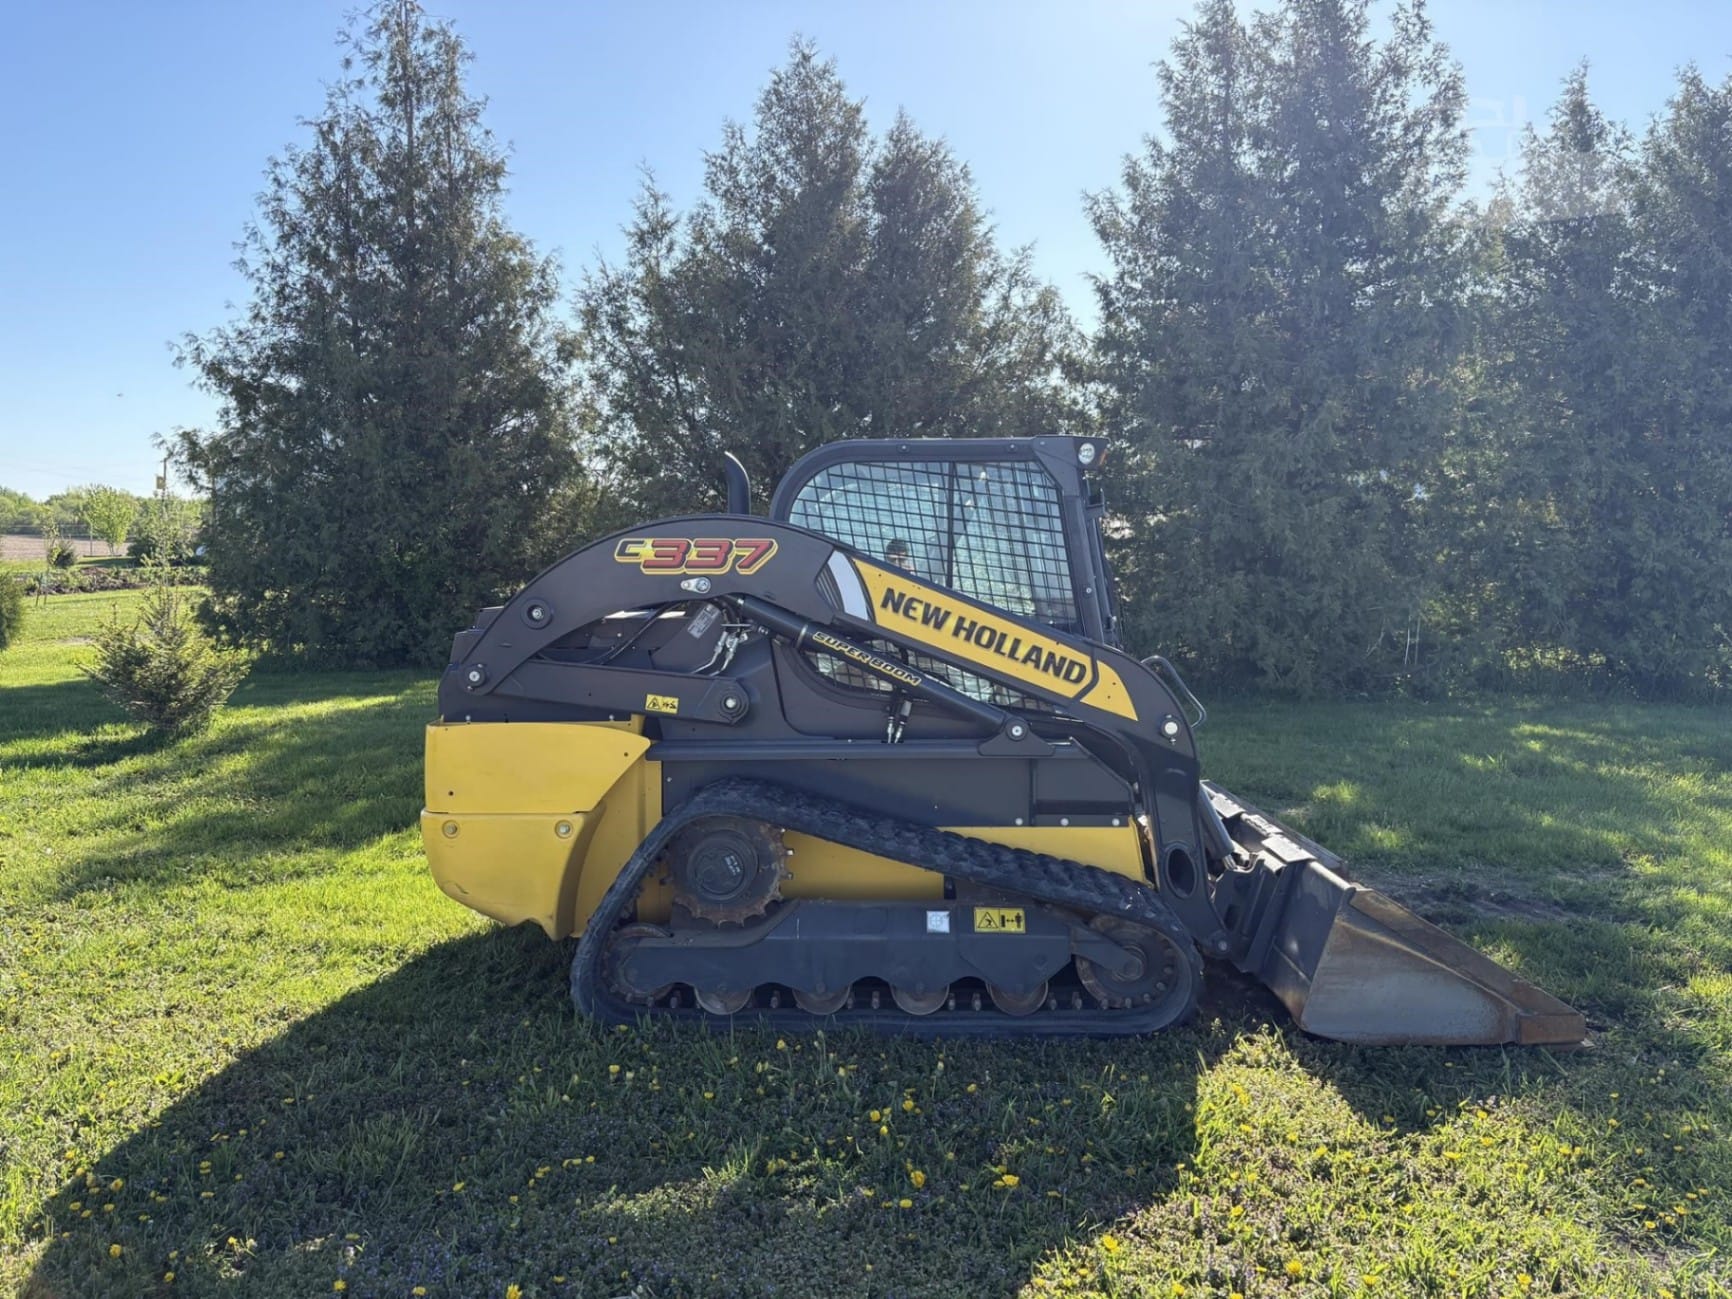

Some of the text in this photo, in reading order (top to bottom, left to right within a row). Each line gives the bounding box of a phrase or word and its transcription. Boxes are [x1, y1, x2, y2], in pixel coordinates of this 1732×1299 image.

[614, 538, 779, 575] C337
[880, 587, 1087, 685] NEW HOLLAND
